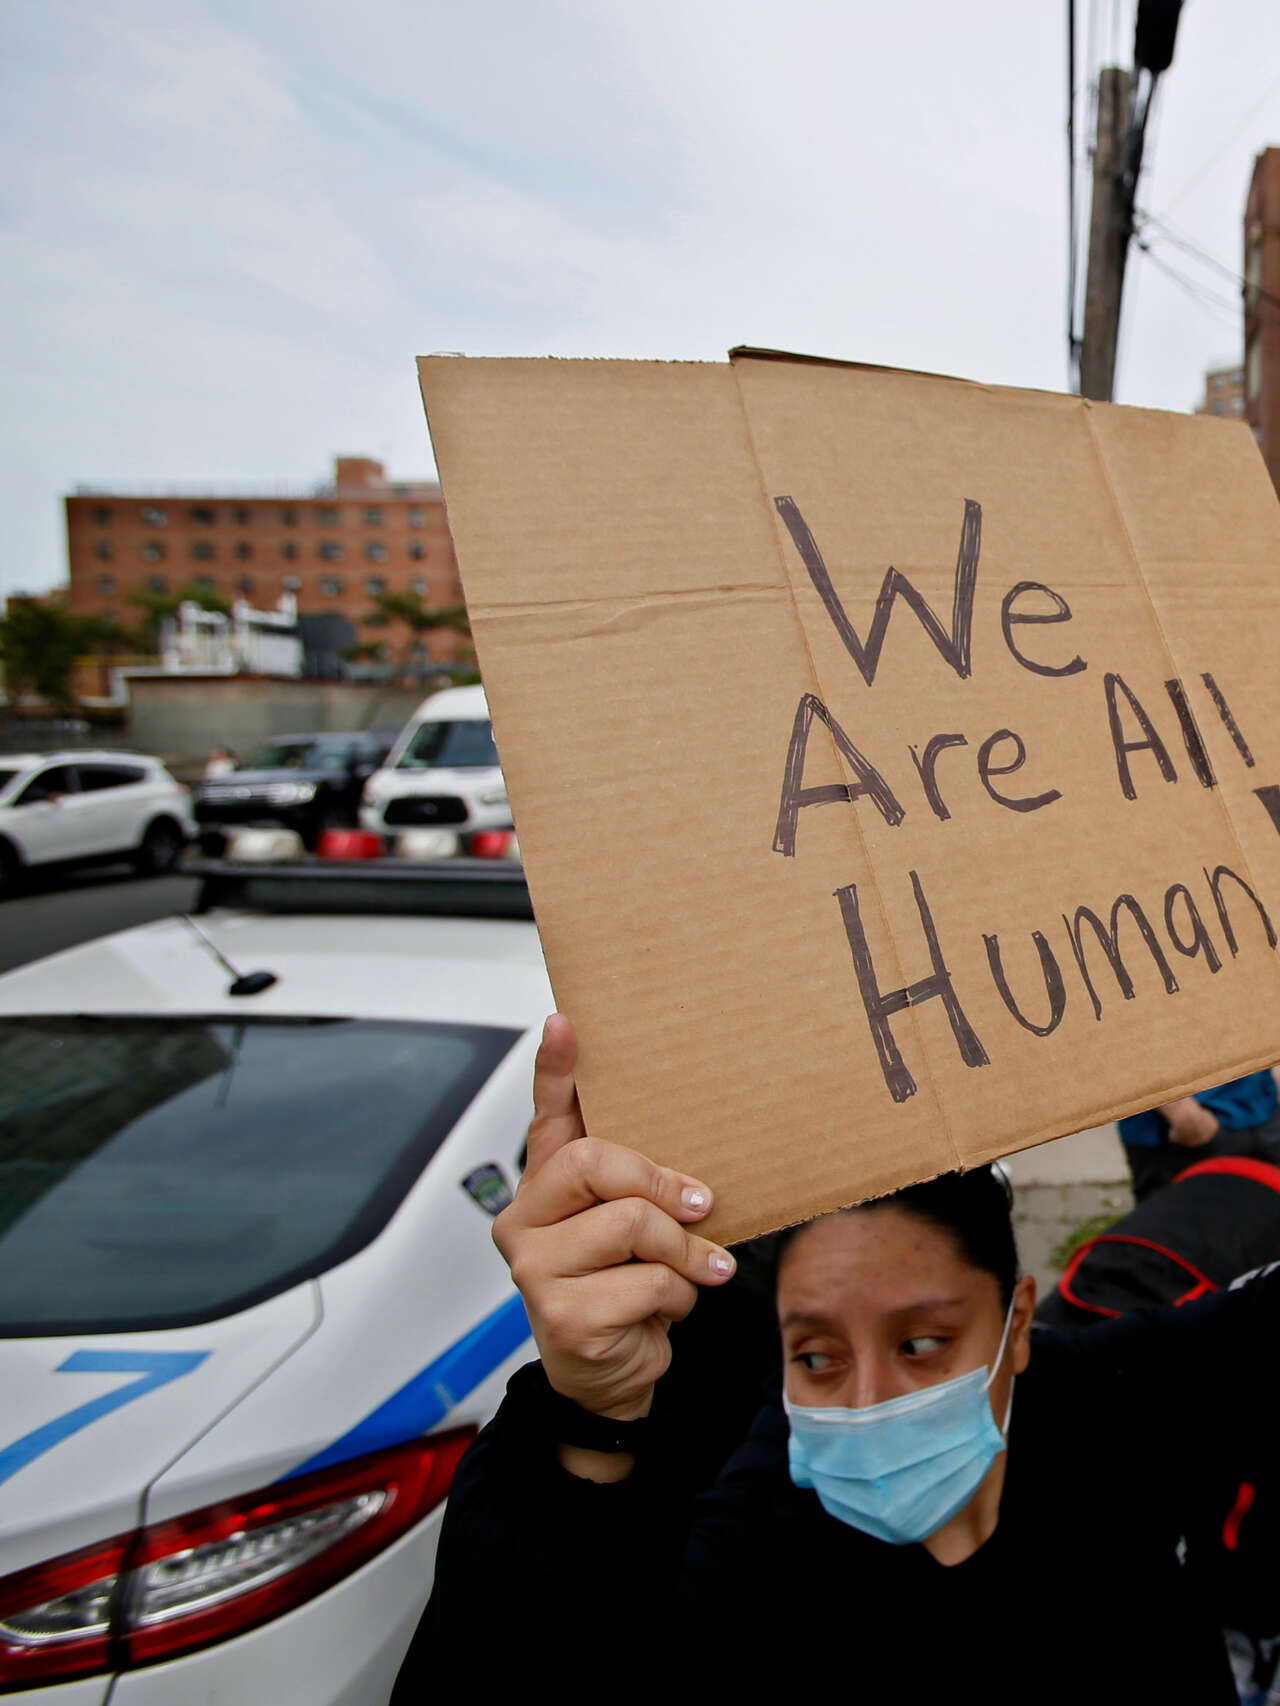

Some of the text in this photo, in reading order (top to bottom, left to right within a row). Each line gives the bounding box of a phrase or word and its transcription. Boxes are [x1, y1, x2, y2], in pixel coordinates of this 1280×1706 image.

[774, 495, 1088, 687] We
[772, 672, 1256, 857] Are All
